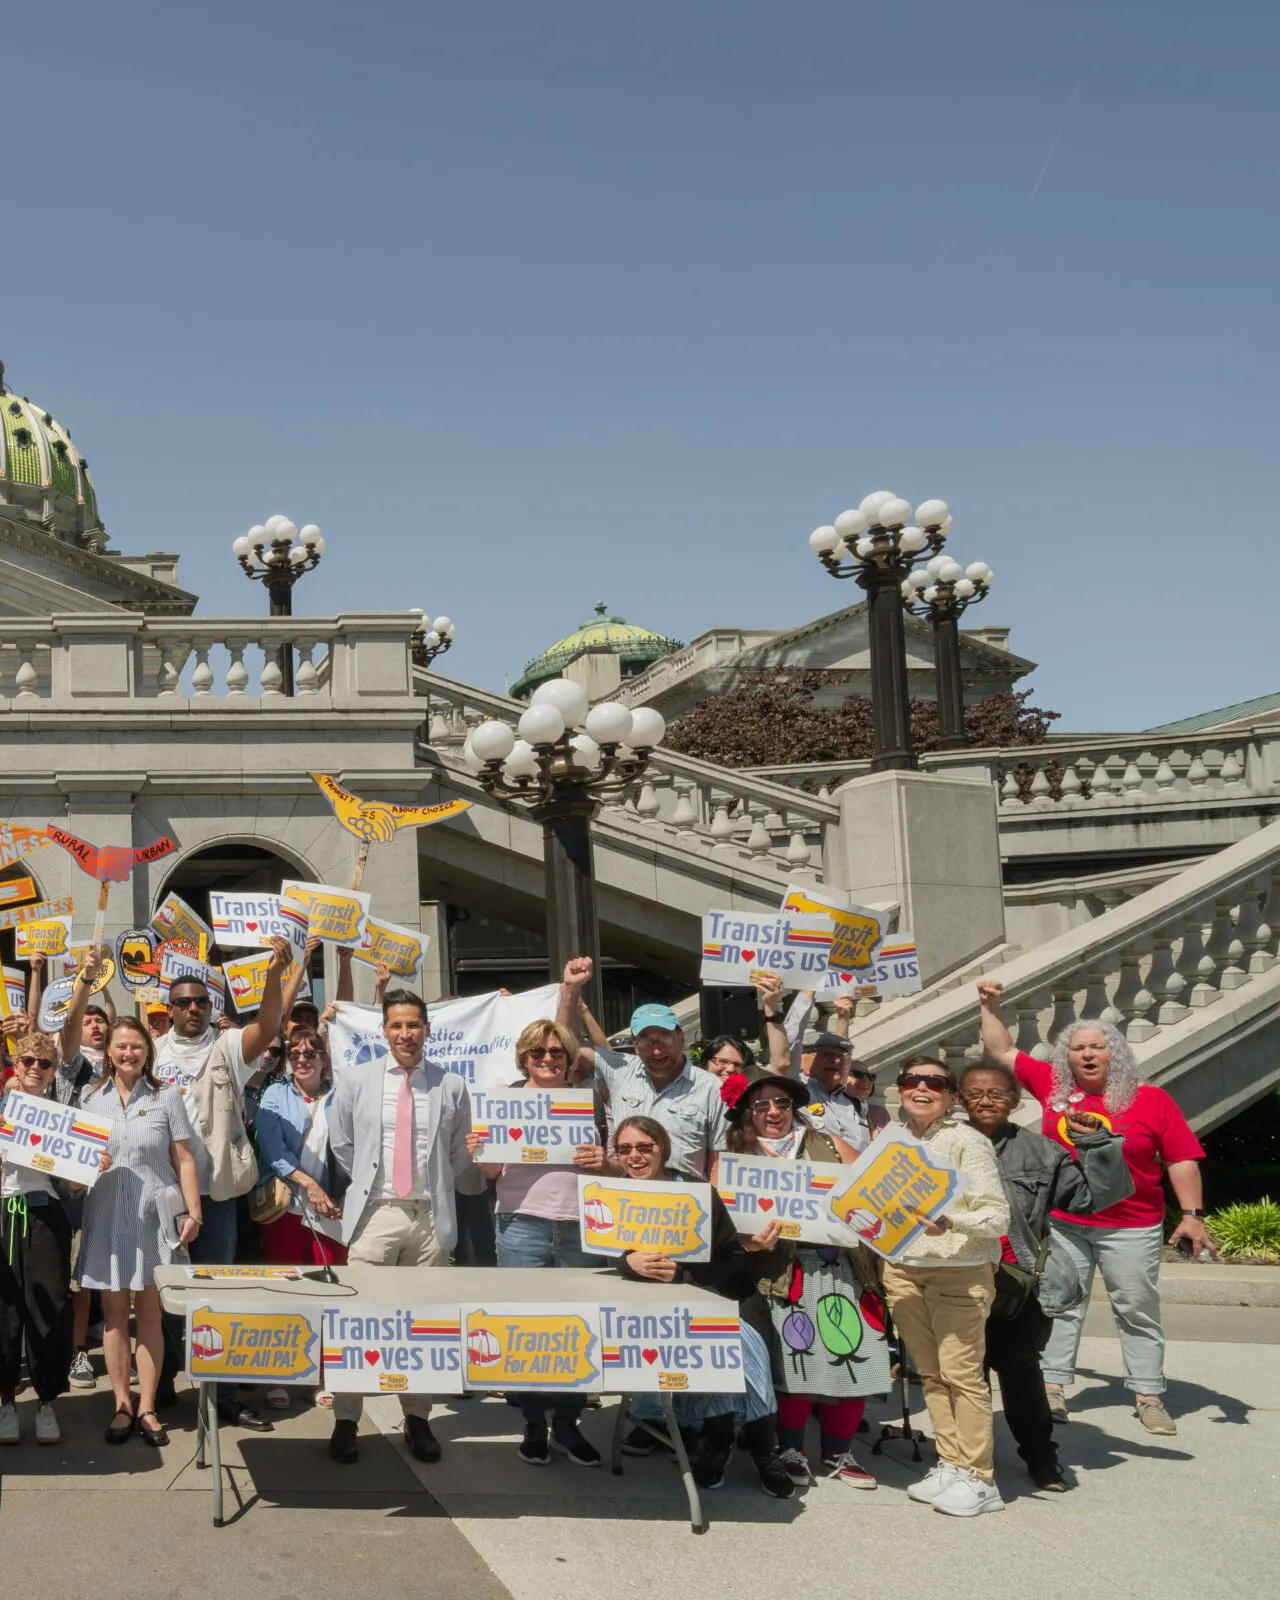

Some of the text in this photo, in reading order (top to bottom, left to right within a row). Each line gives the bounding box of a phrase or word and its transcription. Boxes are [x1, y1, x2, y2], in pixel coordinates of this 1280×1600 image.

[324, 776, 356, 804] TRANSIT
[360, 810, 376, 820] IS
[53, 830, 171, 864] RURAL URBAN
[23, 899, 70, 923] LINES
[211, 895, 281, 917] Transit
[308, 896, 356, 922] Transit
[28, 926, 61, 940] Transit
[176, 914, 200, 944] Trans
[228, 918, 308, 951] mves us
[319, 917, 333, 932] All
[334, 919, 351, 935] PA!
[710, 912, 792, 945] Transit
[834, 919, 873, 946] nsit
[375, 931, 415, 959] Transit
[720, 943, 829, 972] mves us
[828, 961, 919, 987] mves us
[425, 1030, 464, 1044] stice
[8, 1093, 78, 1135] Transit
[472, 1091, 553, 1120] Transit
[12, 1124, 102, 1168] mves us
[488, 1123, 595, 1146] mves us
[722, 1157, 816, 1194] Transit
[858, 1150, 921, 1212] Transit
[618, 1198, 691, 1227] Transit
[734, 1191, 819, 1221] mves
[883, 1171, 939, 1229] For All PA!
[616, 1224, 687, 1247] For All PA!
[228, 1321, 302, 1348] Transit
[324, 1308, 415, 1341] Transit
[600, 1306, 692, 1339] Transit
[504, 1325, 580, 1352] Transit
[225, 1350, 297, 1368] For All PA!
[342, 1346, 460, 1371] mves us
[504, 1354, 578, 1374] For All PA!
[620, 1344, 741, 1370] mves us
